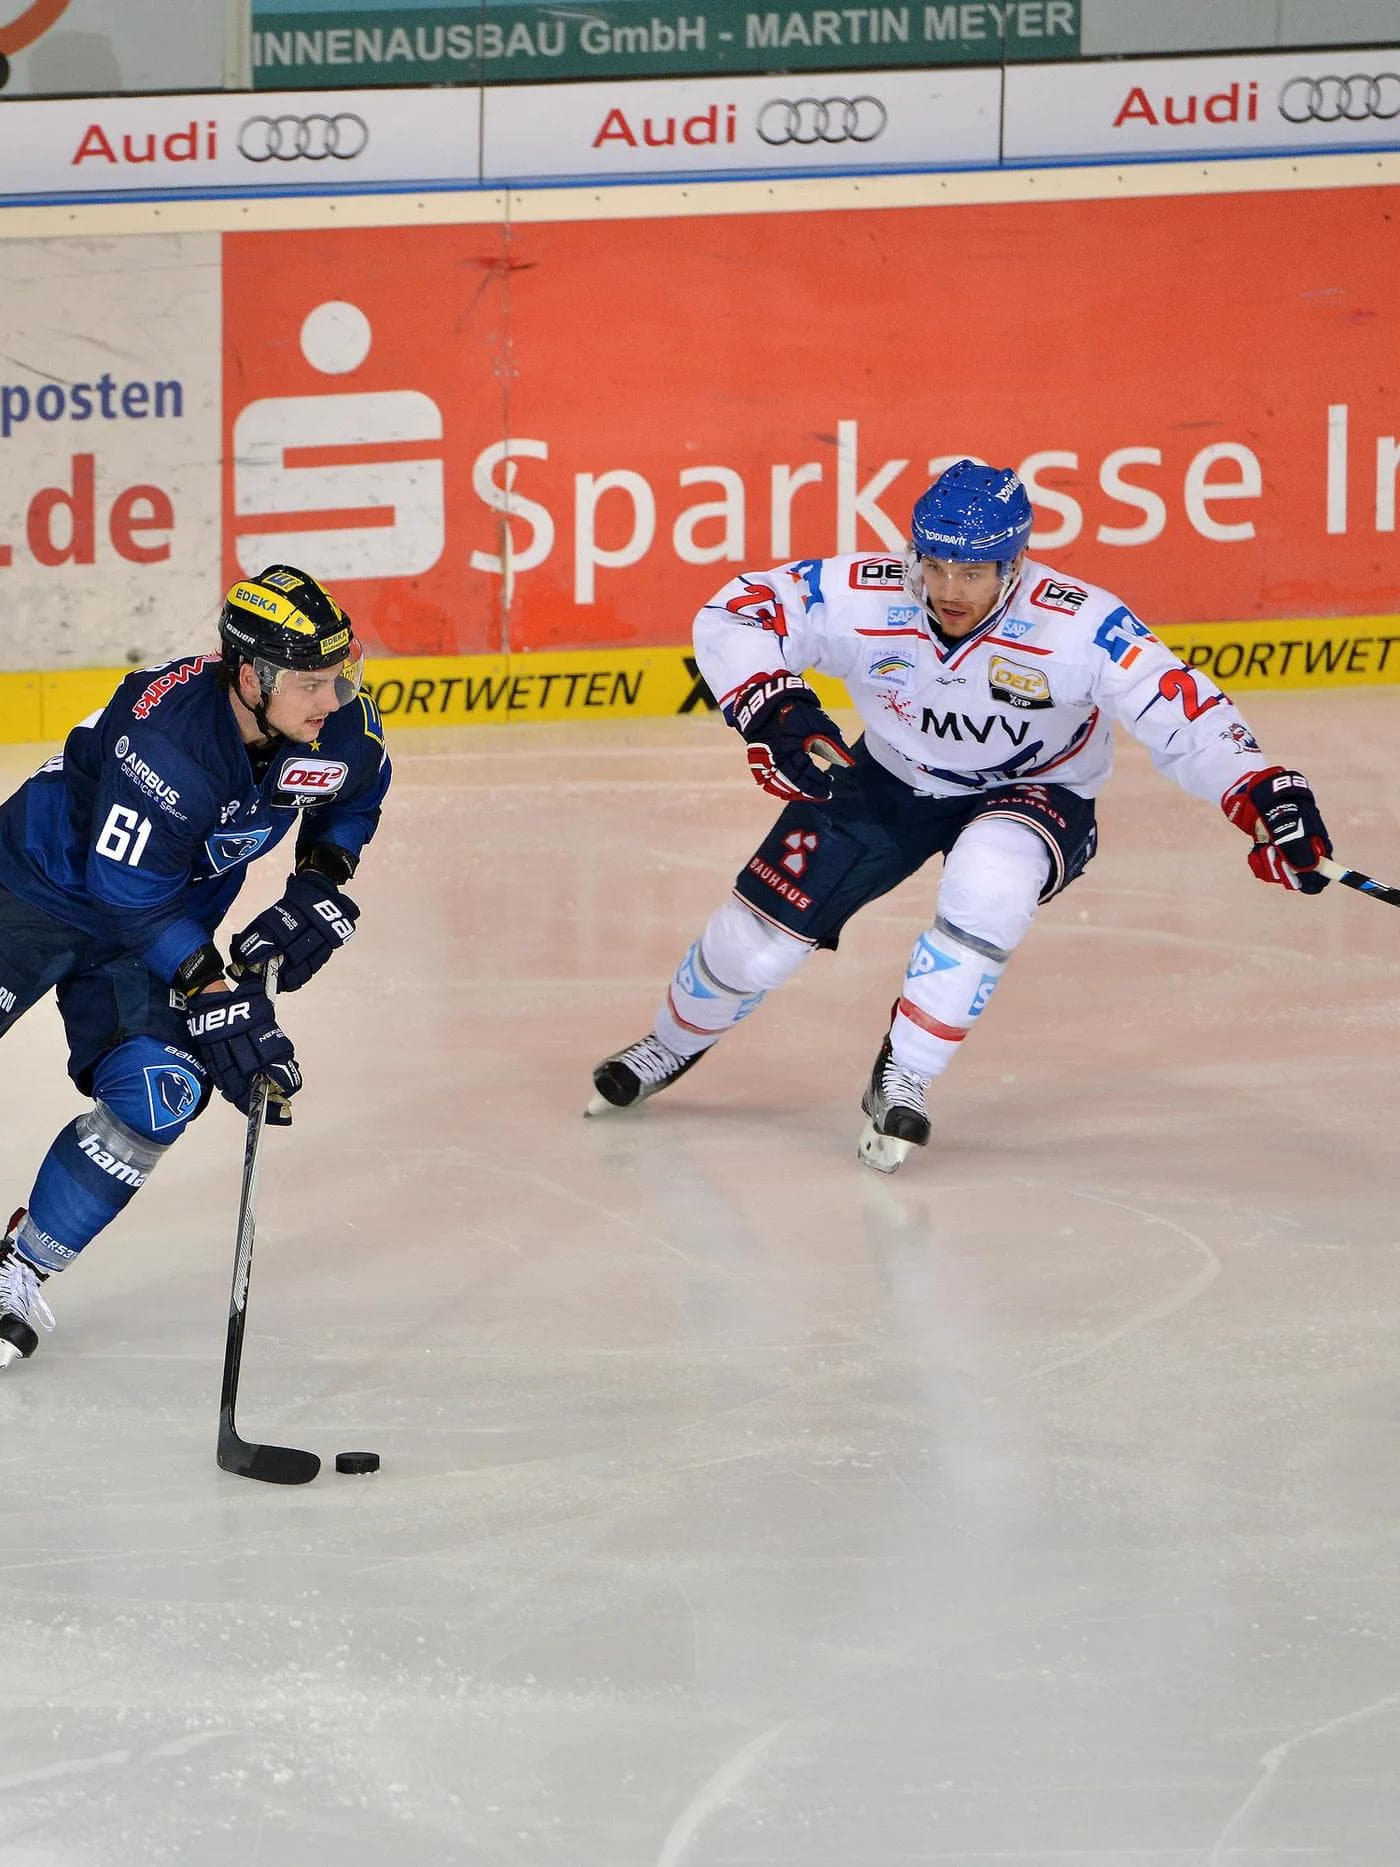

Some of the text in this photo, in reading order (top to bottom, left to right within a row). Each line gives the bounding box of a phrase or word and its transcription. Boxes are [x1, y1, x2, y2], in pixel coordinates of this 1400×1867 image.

[253, 22, 566, 66] INNENAUSBAU
[579, 16, 708, 54] GmbH
[745, 7, 909, 49] MARTIN
[923, 0, 1075, 42] MEYER
[591, 104, 738, 148] Audi
[1112, 82, 1259, 128] Audi
[71, 121, 219, 165] Audi
[469, 419, 1262, 605] Sparksse
[933, 533, 967, 547] DURAVIT
[235, 588, 279, 615] EDEKA
[888, 607, 915, 623] SAP
[322, 630, 349, 648] EDEKA
[1003, 621, 1026, 635] SAP
[996, 669, 1036, 693] DEL
[920, 707, 1031, 747] MVV
[120, 762, 154, 797] DEFENCE
[159, 801, 188, 822] SPACE
[125, 751, 181, 806] AIRBUS
[282, 769, 332, 788] DEL
[95, 803, 153, 867] 61
[749, 857, 813, 911] BAUHAUS
